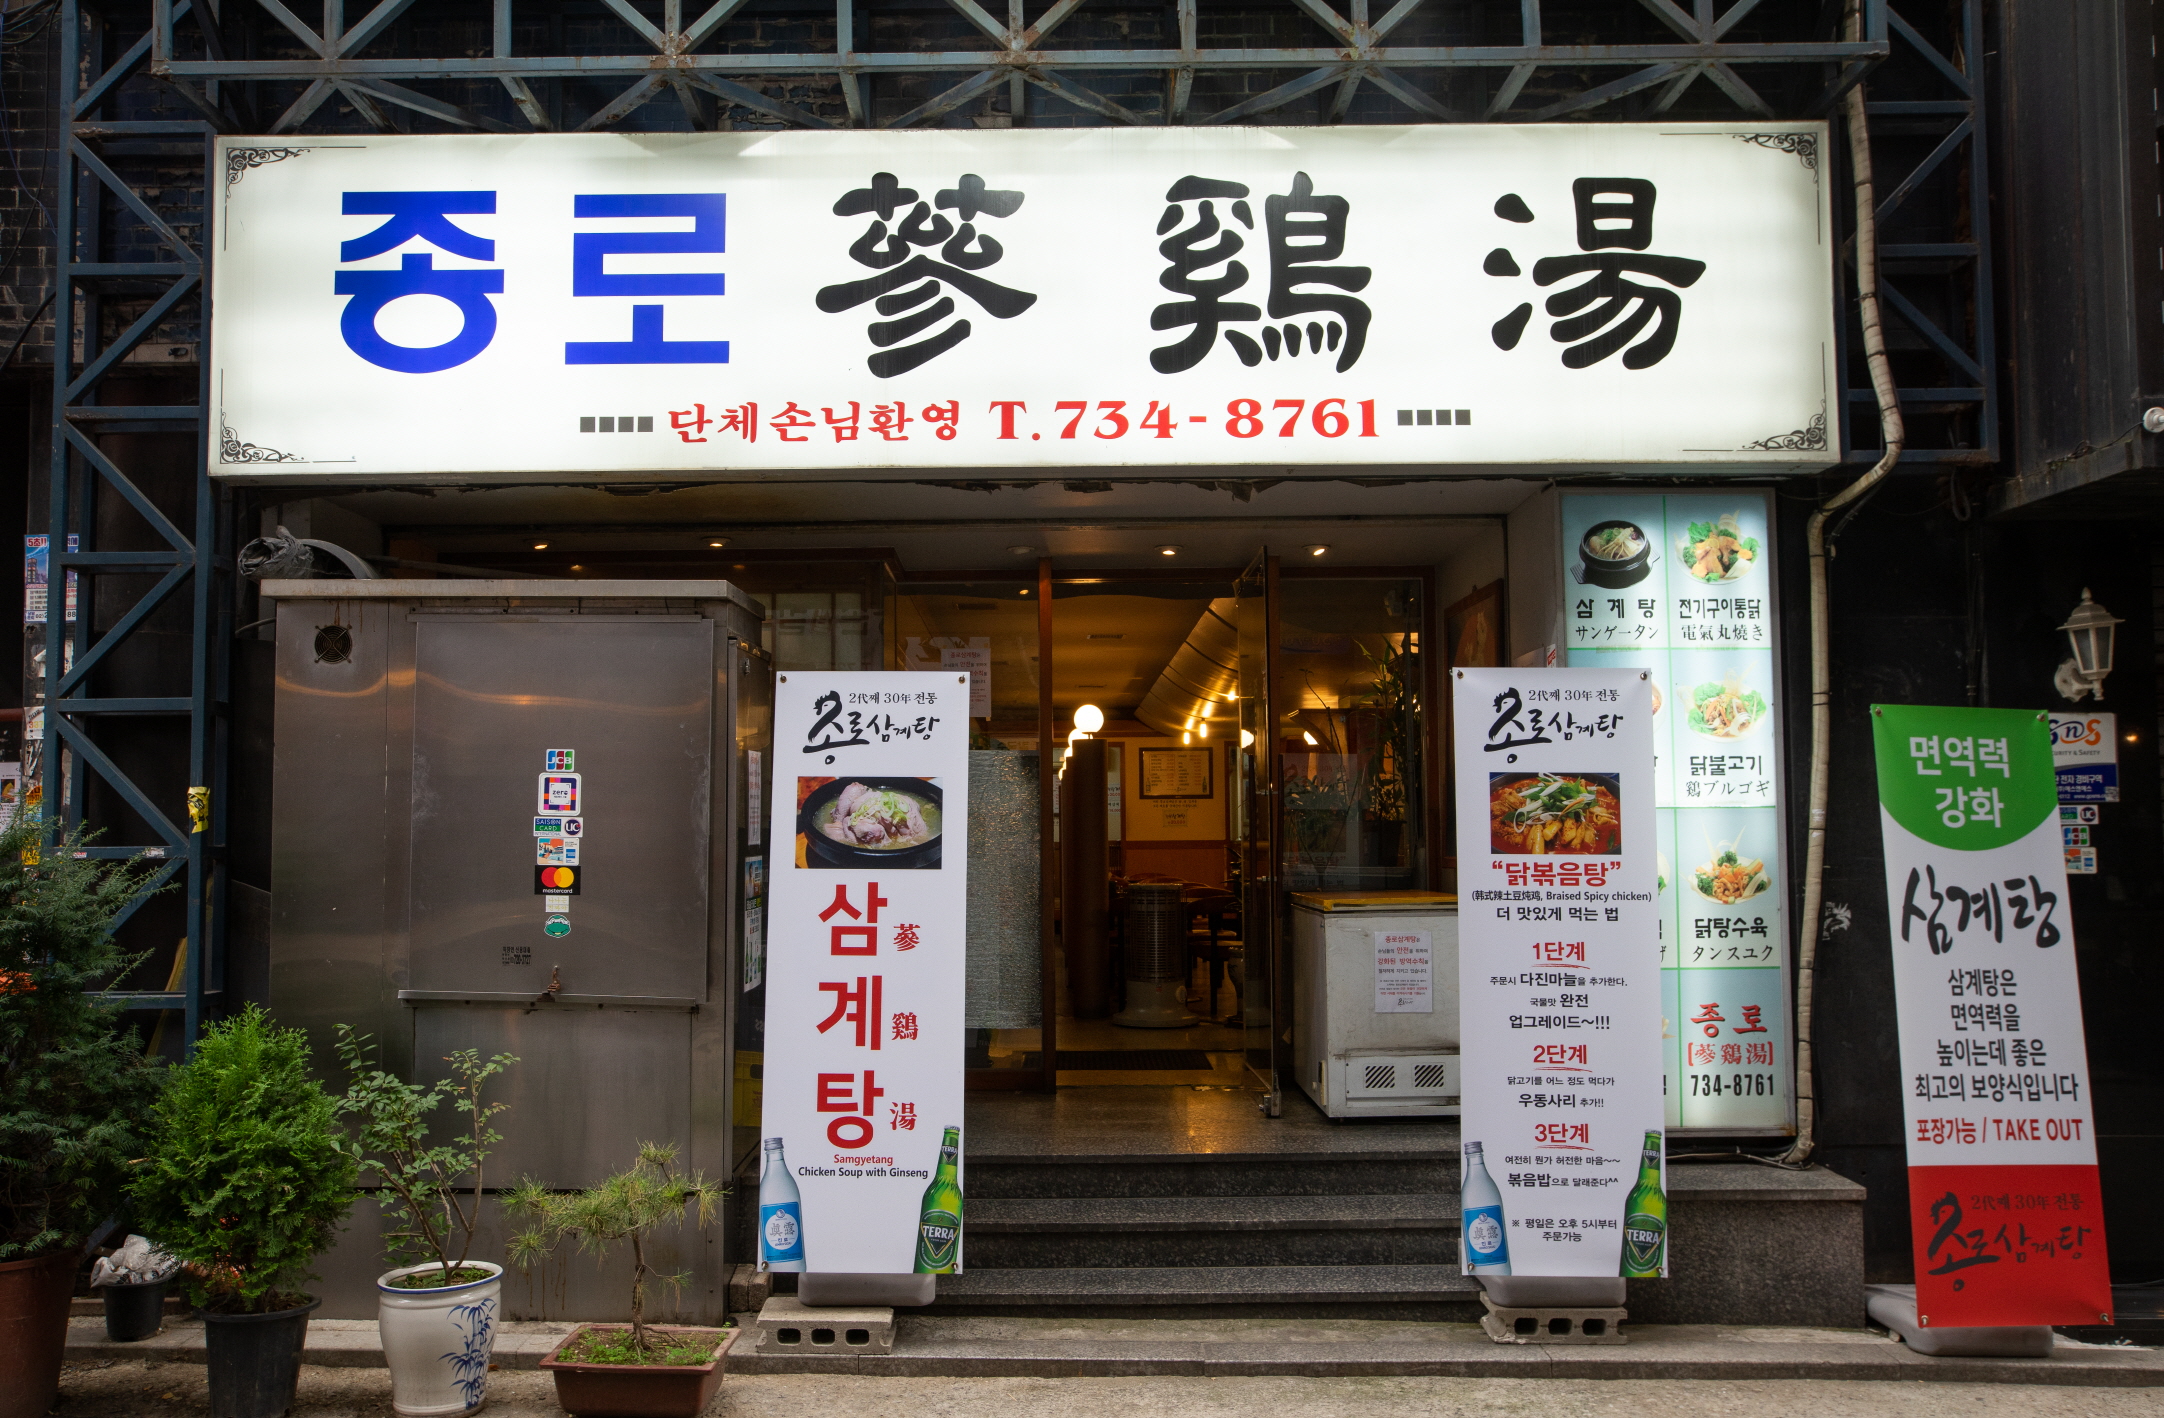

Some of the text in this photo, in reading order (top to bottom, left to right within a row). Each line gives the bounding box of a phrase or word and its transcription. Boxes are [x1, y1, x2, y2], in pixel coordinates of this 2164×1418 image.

[334, 190, 730, 373] 종로
[1576, 599, 1656, 619] 삼계탕
[1679, 598, 1761, 619] 전기구이통닭
[1575, 624, 1659, 642] サンゲータン
[883, 693, 912, 705] 30年
[913, 692, 938, 705] 전통
[1564, 690, 1593, 702] 30年
[1595, 689, 1621, 702] 전통
[547, 756, 572, 765] JCB
[1689, 755, 1763, 776] 닭불고기
[1909, 735, 2011, 779] 면역력
[1935, 786, 2005, 829] 강화
[1546, 891, 1581, 901] Braised
[1584, 891, 1610, 903] Spicy
[1611, 891, 1652, 903] chicken)
[1496, 907, 1619, 922] 더 맛있게 먹는 법
[1901, 864, 2061, 956] 삼계탕
[1694, 916, 1768, 939] 닭탕수육
[1532, 941, 1585, 962] 1단계
[1692, 945, 1773, 963] タンスユク
[1489, 972, 1628, 987] 주문시 다진마늘을 추가한다.
[1947, 969, 2018, 998] 삼계탕은
[1529, 993, 1589, 1008] 국물맛 완전
[1689, 1002, 1768, 1038] 종로
[1950, 1003, 2021, 1033] 면역력을
[1533, 1044, 1588, 1065] 2단계
[1936, 1038, 2047, 1068] 높이는데 좋은
[1507, 1076, 1615, 1087] 닭고기를 어느 정도 먹다가
[1690, 1073, 1774, 1097] 734-8761
[1915, 1074, 2079, 1103] 최고의 보양식입니다
[1518, 1094, 1605, 1109] 우동사리 추가!!
[1534, 1123, 1590, 1144] 3단계
[1917, 1117, 1977, 1145] 포장가능
[1993, 1118, 2042, 1141] TAKE
[2045, 1118, 2084, 1141] OUT
[941, 1145, 958, 1155] TERRA
[1643, 1149, 1660, 1158] TERRA
[833, 1154, 894, 1166] Samgyetang
[1504, 1155, 1532, 1166] 여전히
[1534, 1156, 1553, 1166] 뭔가
[1555, 1156, 1583, 1166] 허전한
[798, 1167, 929, 1180] Chicken Soup with Ginseng
[1507, 1173, 1570, 1188] 볶음밥으로
[2053, 1193, 2085, 1211] 전통
[922, 1225, 955, 1241] TERRA
[1525, 1218, 1555, 1230] 평일은
[1558, 1218, 1579, 1229] 오후
[1581, 1219, 1618, 1230] 5시부터
[1542, 1231, 1583, 1242] 주문가능
[1626, 1228, 1660, 1245] TERRA
